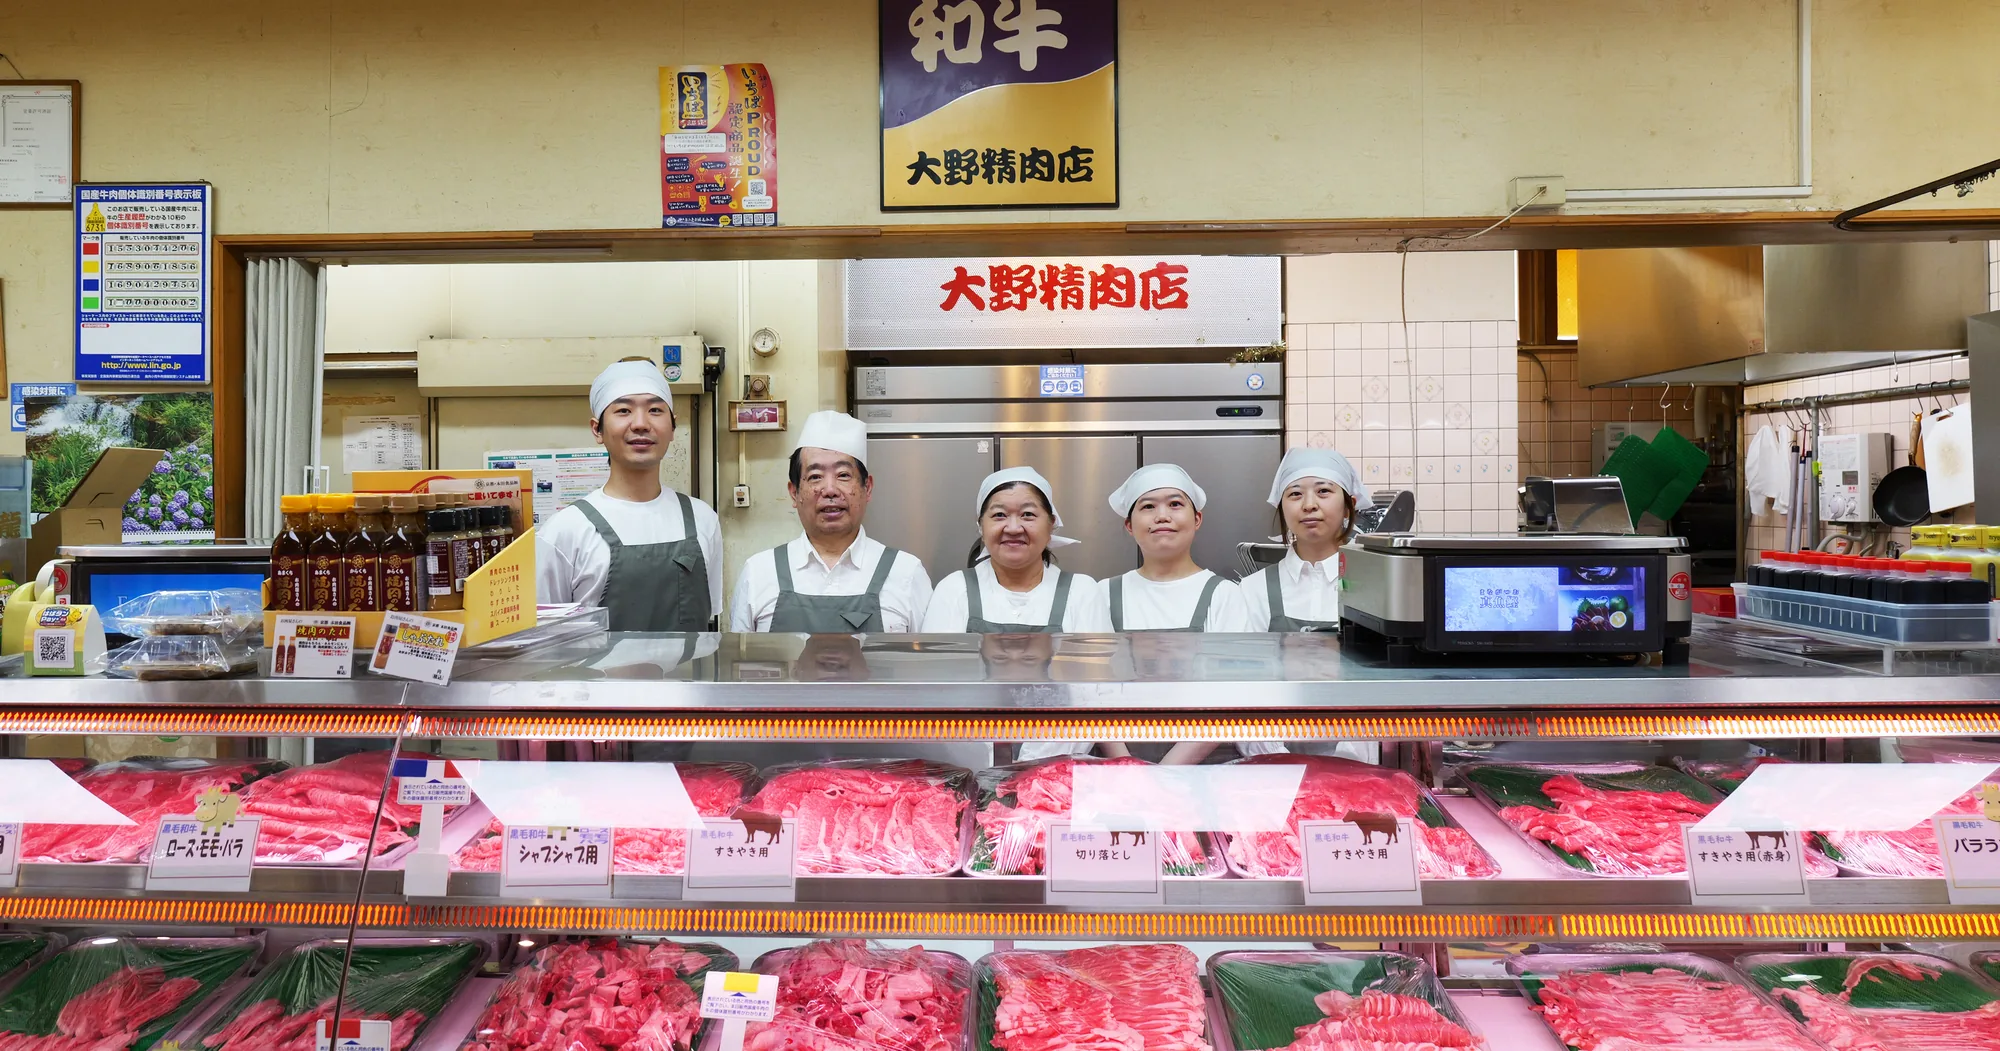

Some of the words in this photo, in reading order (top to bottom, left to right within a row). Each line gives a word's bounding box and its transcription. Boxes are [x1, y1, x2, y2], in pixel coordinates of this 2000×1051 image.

[908, 0, 1068, 73] 和牛
[906, 145, 1095, 186] 大野精肉店
[81, 189, 202, 200] 国産牛肉個体識別番号表示板
[940, 263, 1188, 312] 大野精肉店
[22, 386, 66, 396] 感染対策に
[297, 626, 347, 636] 焼肉のたれ
[402, 628, 444, 647] しゃぶたれ
[162, 824, 197, 834] 黒毛和牛
[510, 829, 546, 839] 黒毛和牛
[701, 830, 734, 839] 黒毛和牛
[1061, 833, 1095, 842] 黒毛和牛
[1315, 833, 1349, 842] 黒毛和牛
[1697, 835, 1733, 844] 黒毛和牛
[1954, 838, 2000, 853] バラう
[519, 844, 597, 864] シャブシャブ用
[715, 846, 768, 858] すきやき用
[1076, 849, 1130, 860] 切り落とし
[1332, 848, 1388, 860] すきやき用
[1698, 850, 1791, 863] すきやき用(赤身)
